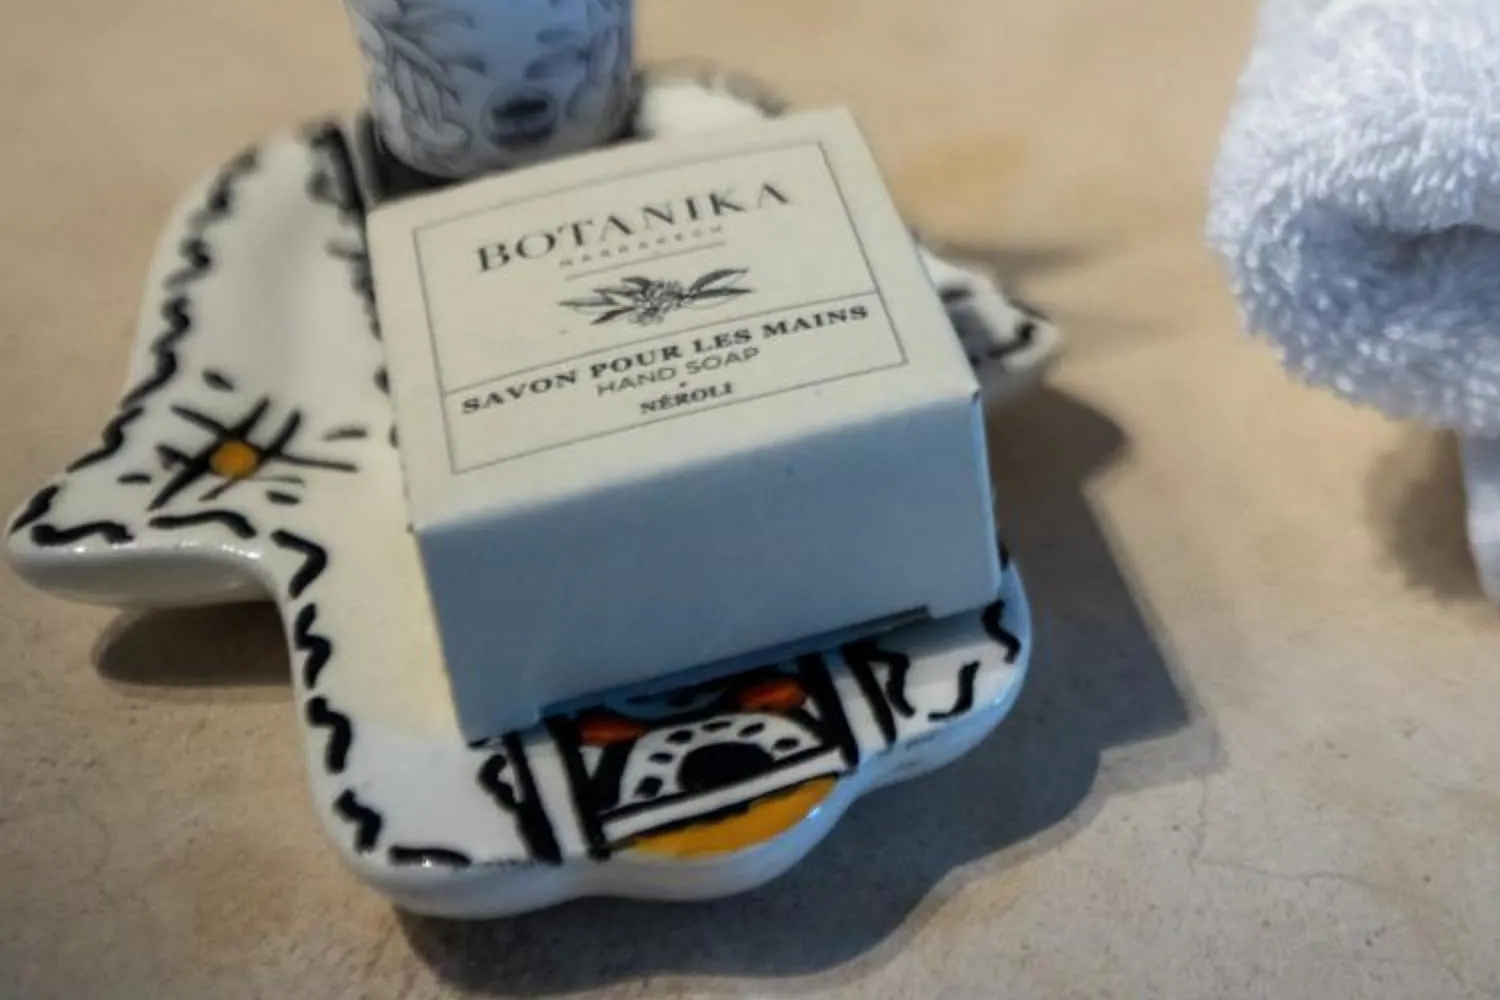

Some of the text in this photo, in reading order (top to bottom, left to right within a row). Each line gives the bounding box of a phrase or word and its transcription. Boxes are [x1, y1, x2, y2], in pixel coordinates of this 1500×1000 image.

[477, 183, 791, 272] BOTANIKA
[461, 304, 869, 414] SAVON POUR LES MAINS
[597, 347, 761, 397] HAND SOAP
